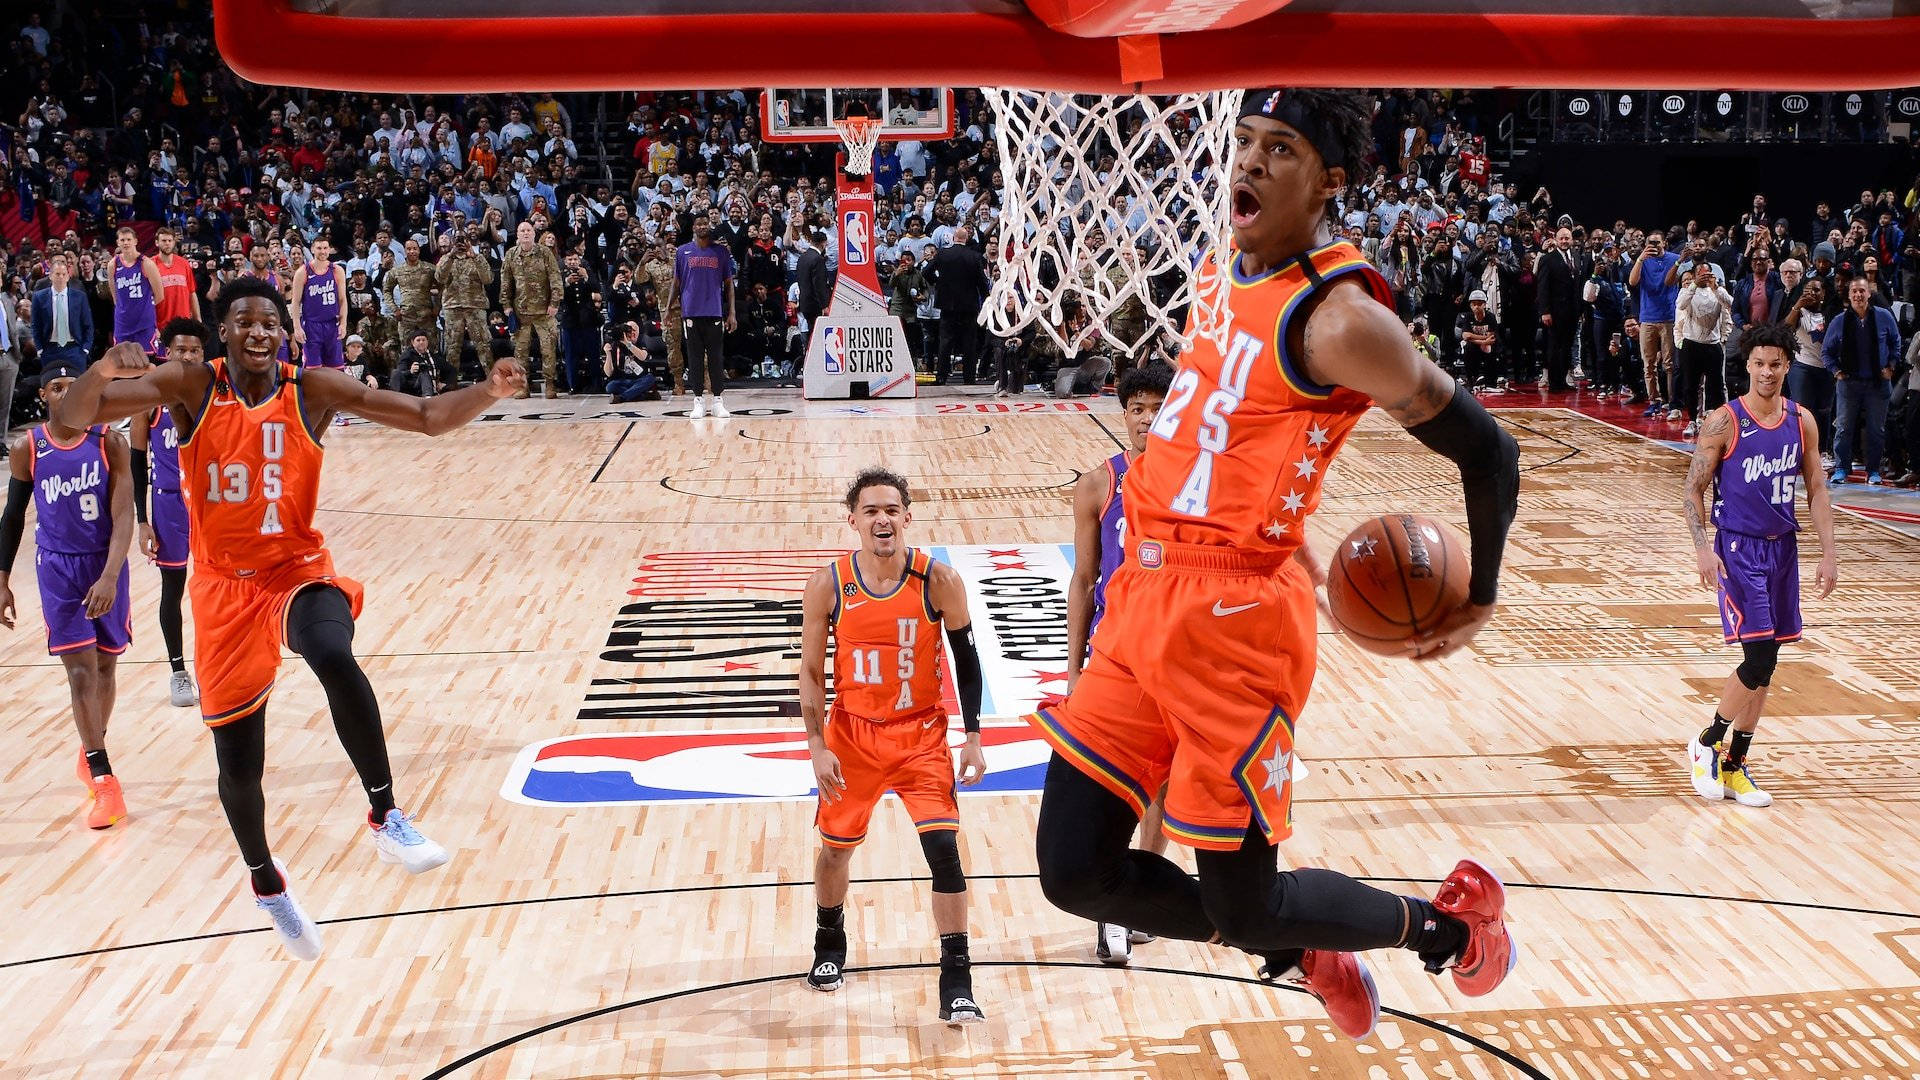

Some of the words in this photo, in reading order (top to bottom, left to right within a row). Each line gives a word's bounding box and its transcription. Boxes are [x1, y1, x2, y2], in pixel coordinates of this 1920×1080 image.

[1469, 158, 1485, 175] 15
[839, 192, 872, 200] SPALDING
[116, 272, 142, 290] World
[129, 285, 143, 299] 21
[308, 279, 335, 297] World
[321, 291, 336, 306] 19
[848, 326, 893, 348] RISING
[849, 349, 893, 373] STARS
[935, 402, 1090, 414] 2020
[1741, 442, 1799, 484] World
[41, 460, 101, 504] World
[206, 462, 250, 503] 13
[1770, 475, 1796, 505] 15
[79, 493, 100, 522] 9
[977, 576, 1069, 662] CHICAGO
[852, 648, 883, 685] 11
